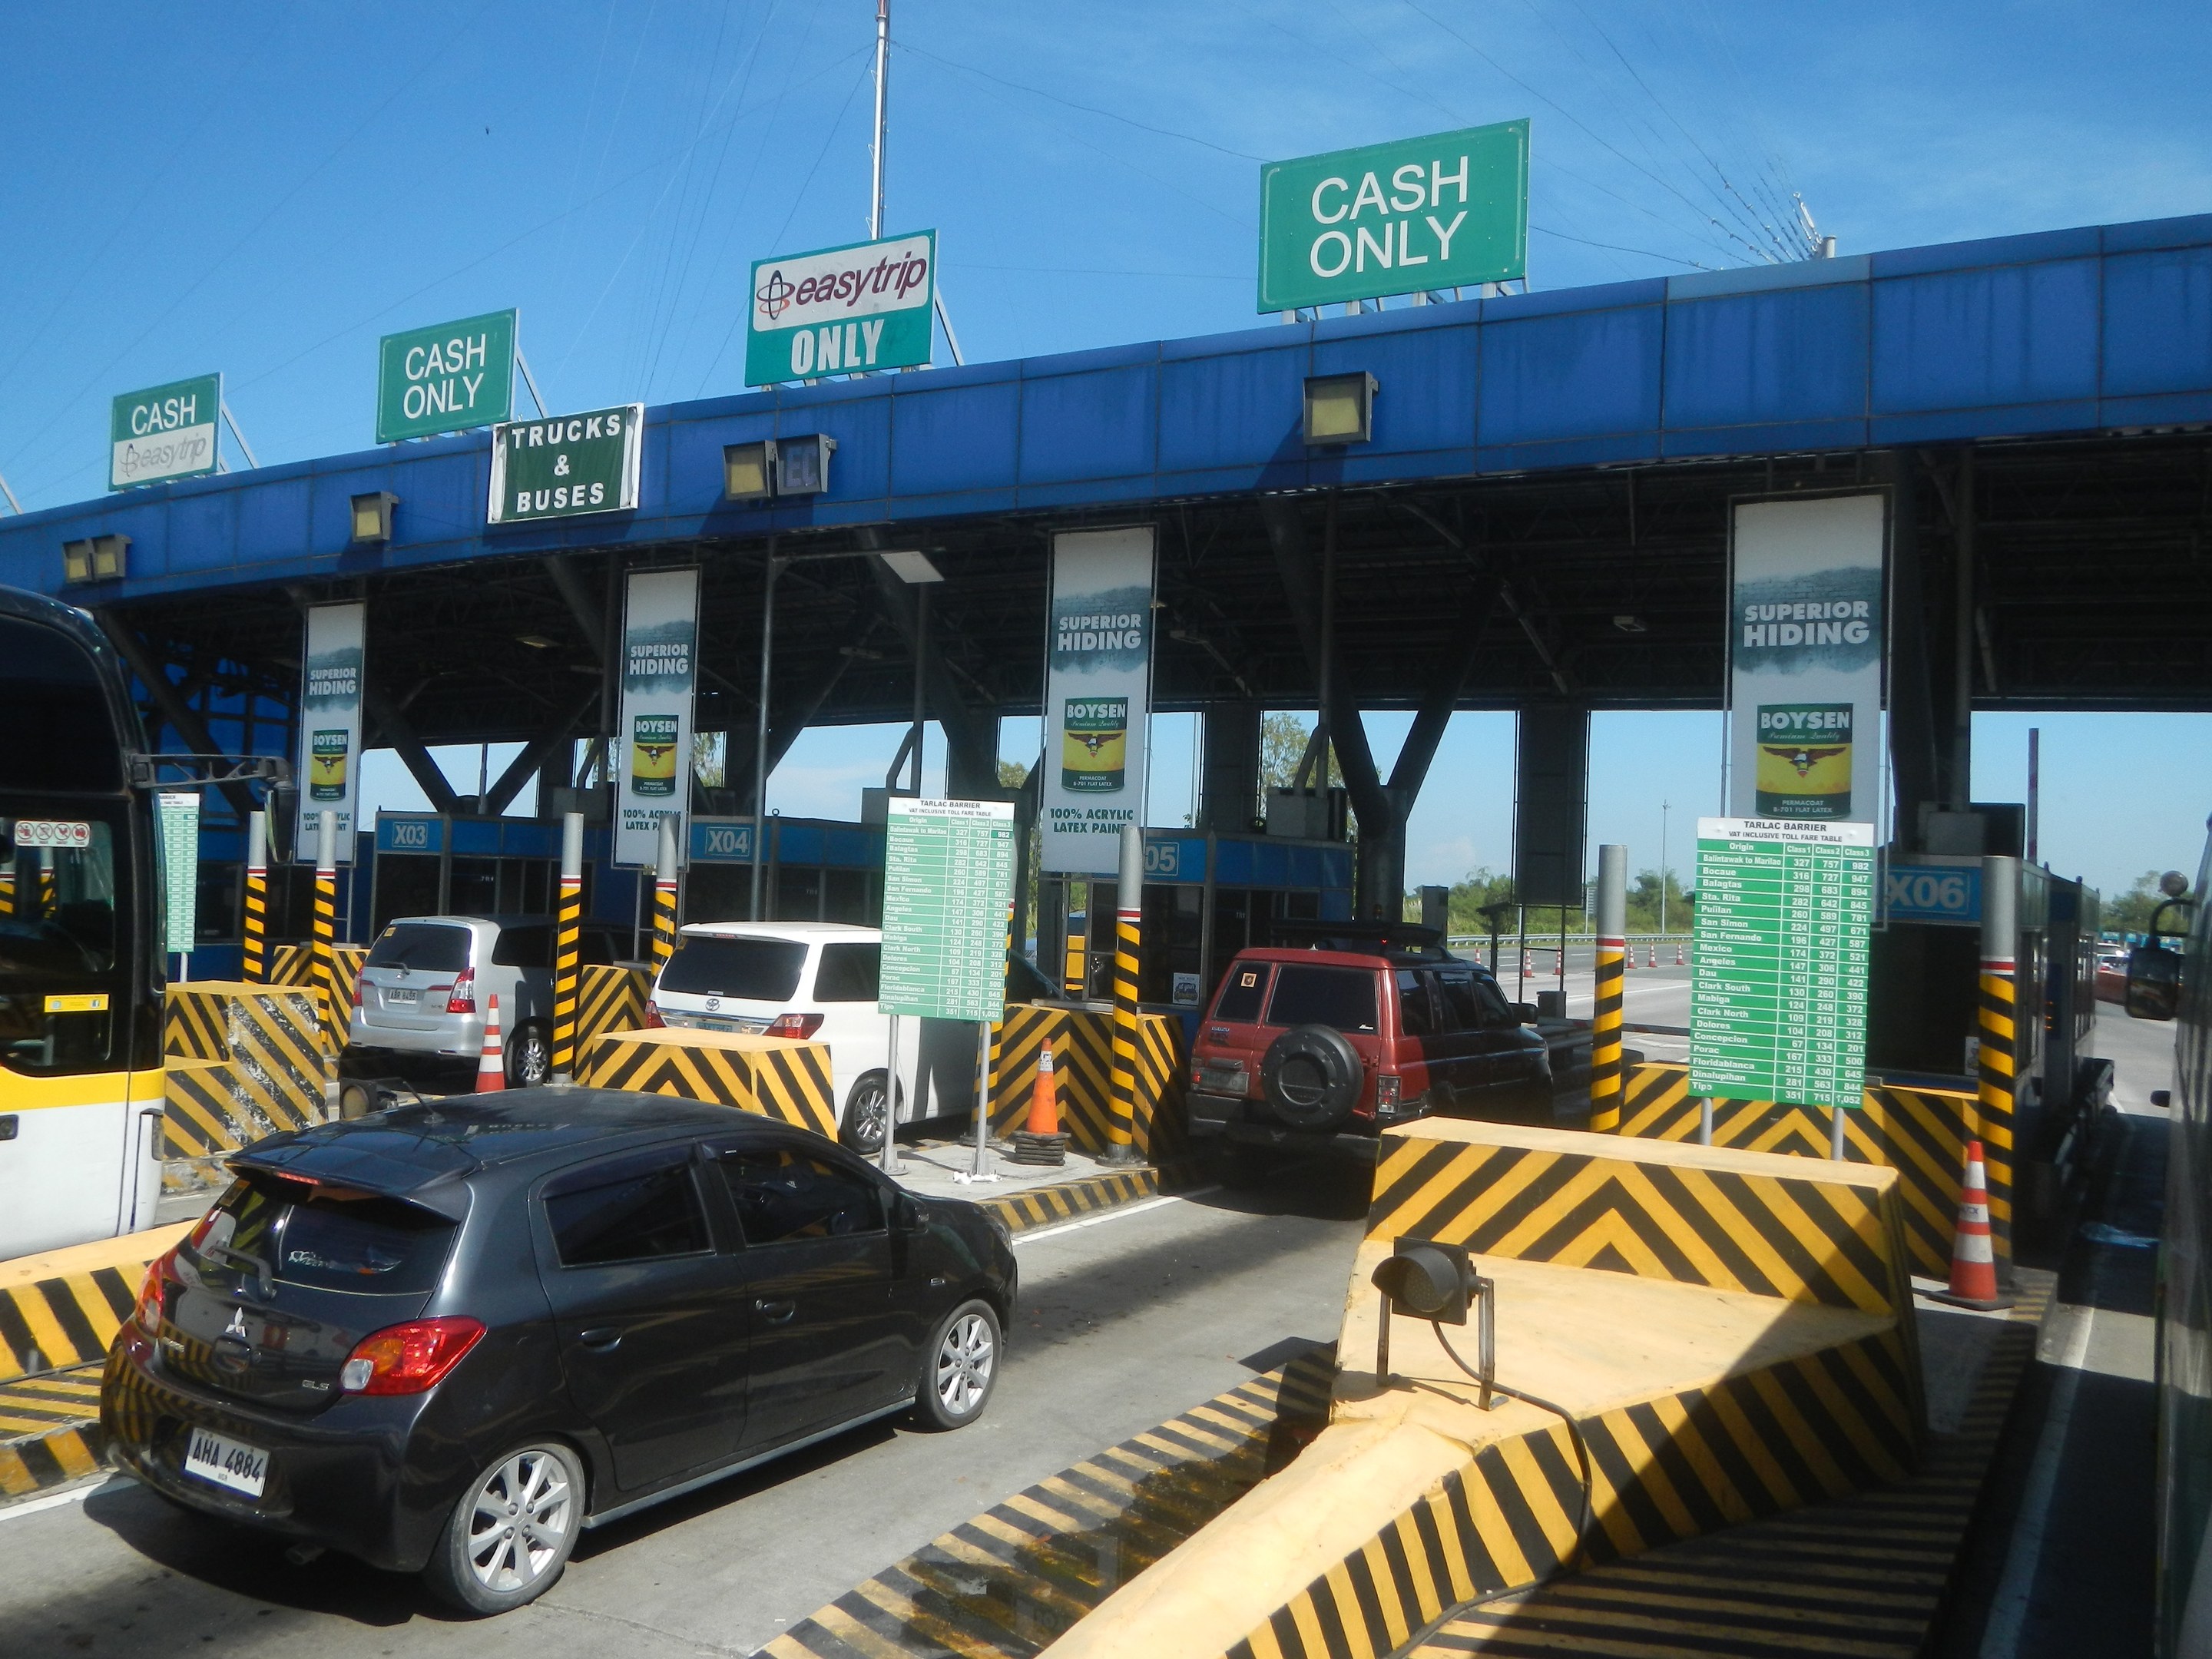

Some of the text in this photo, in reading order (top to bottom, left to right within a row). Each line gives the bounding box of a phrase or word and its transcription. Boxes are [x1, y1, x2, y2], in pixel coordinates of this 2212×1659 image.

[1311, 155, 1469, 224] CASH
[1310, 210, 1468, 278] ONLY
[796, 251, 927, 307] easytrip
[791, 319, 885, 375] ONLY
[406, 333, 486, 380] CASH
[403, 373, 484, 419] ONLY
[131, 394, 196, 435] CASH
[511, 414, 621, 449] TRUCKS
[141, 433, 207, 469] easytrip
[554, 454, 570, 476] &
[517, 482, 604, 513] BUSES
[1744, 601, 1869, 623] SUPERIOR
[1058, 614, 1141, 631] SUPERIOR
[1057, 631, 1141, 652] HIDING
[1743, 621, 1869, 647] HIDING
[630, 644, 688, 657] SUPERIOR
[310, 667, 356, 680] SUPERIOR
[629, 658, 688, 675] HIDING
[309, 680, 356, 696] HIDING
[1067, 704, 1125, 719] BOYSEN
[636, 720, 677, 733] BOYSEN
[1760, 711, 1850, 730] BOYSEN
[313, 734, 347, 746] BOYSEN
[624, 810, 646, 819] 100%
[1050, 808, 1134, 820] 100% ACRYLIC
[625, 821, 650, 830] LATEX
[1054, 822, 1127, 834] LATEX PAIN
[1744, 821, 1780, 830] TARLAC
[394, 825, 426, 845] X03
[708, 830, 748, 853] X04
[1730, 843, 1753, 851] Origin
[1145, 846, 1176, 872] 05
[1703, 867, 1736, 876] Bocaue
[1703, 879, 1742, 889] Balagtas
[1886, 875, 1965, 909] X06
[1793, 898, 1808, 906] 282
[1821, 899, 1837, 908] 642
[1850, 901, 1866, 909] 845
[1792, 910, 1808, 919] 260
[1821, 912, 1836, 920] 589
[1820, 925, 1836, 933] 497
[1720, 932, 1761, 941] Fernando
[1820, 938, 1836, 946] 427
[1700, 944, 1732, 952] Mexico
[1820, 951, 1835, 959] 372
[1700, 956, 1735, 965] Angeles
[1819, 964, 1835, 972] 306
[1699, 982, 1722, 990] Clark
[1725, 983, 1750, 992] South
[1790, 988, 1805, 996] 130
[1847, 979, 1863, 987] 422
[1698, 994, 1863, 1013] Mabiga 124 248 372
[1697, 1020, 1730, 1029] Dolores
[1724, 1009, 1748, 1018] North
[1789, 1014, 1803, 1022] 109
[1817, 1016, 1833, 1025] 219
[1694, 1032, 1747, 1043] Concepcion
[1694, 1045, 1719, 1054] Porac
[1816, 1055, 1832, 1063] 333
[1846, 1057, 1863, 1065] 500
[1693, 1058, 1861, 1078] Floridablanca 215 430 645
[1693, 1070, 1745, 1081] Dinalupihan
[1814, 1081, 1831, 1089] 563
[1786, 1091, 1801, 1099] 351
[1814, 1093, 1830, 1101] 715
[302, 1379, 329, 1391] GLS
[193, 1436, 263, 1482] AHA 4884
